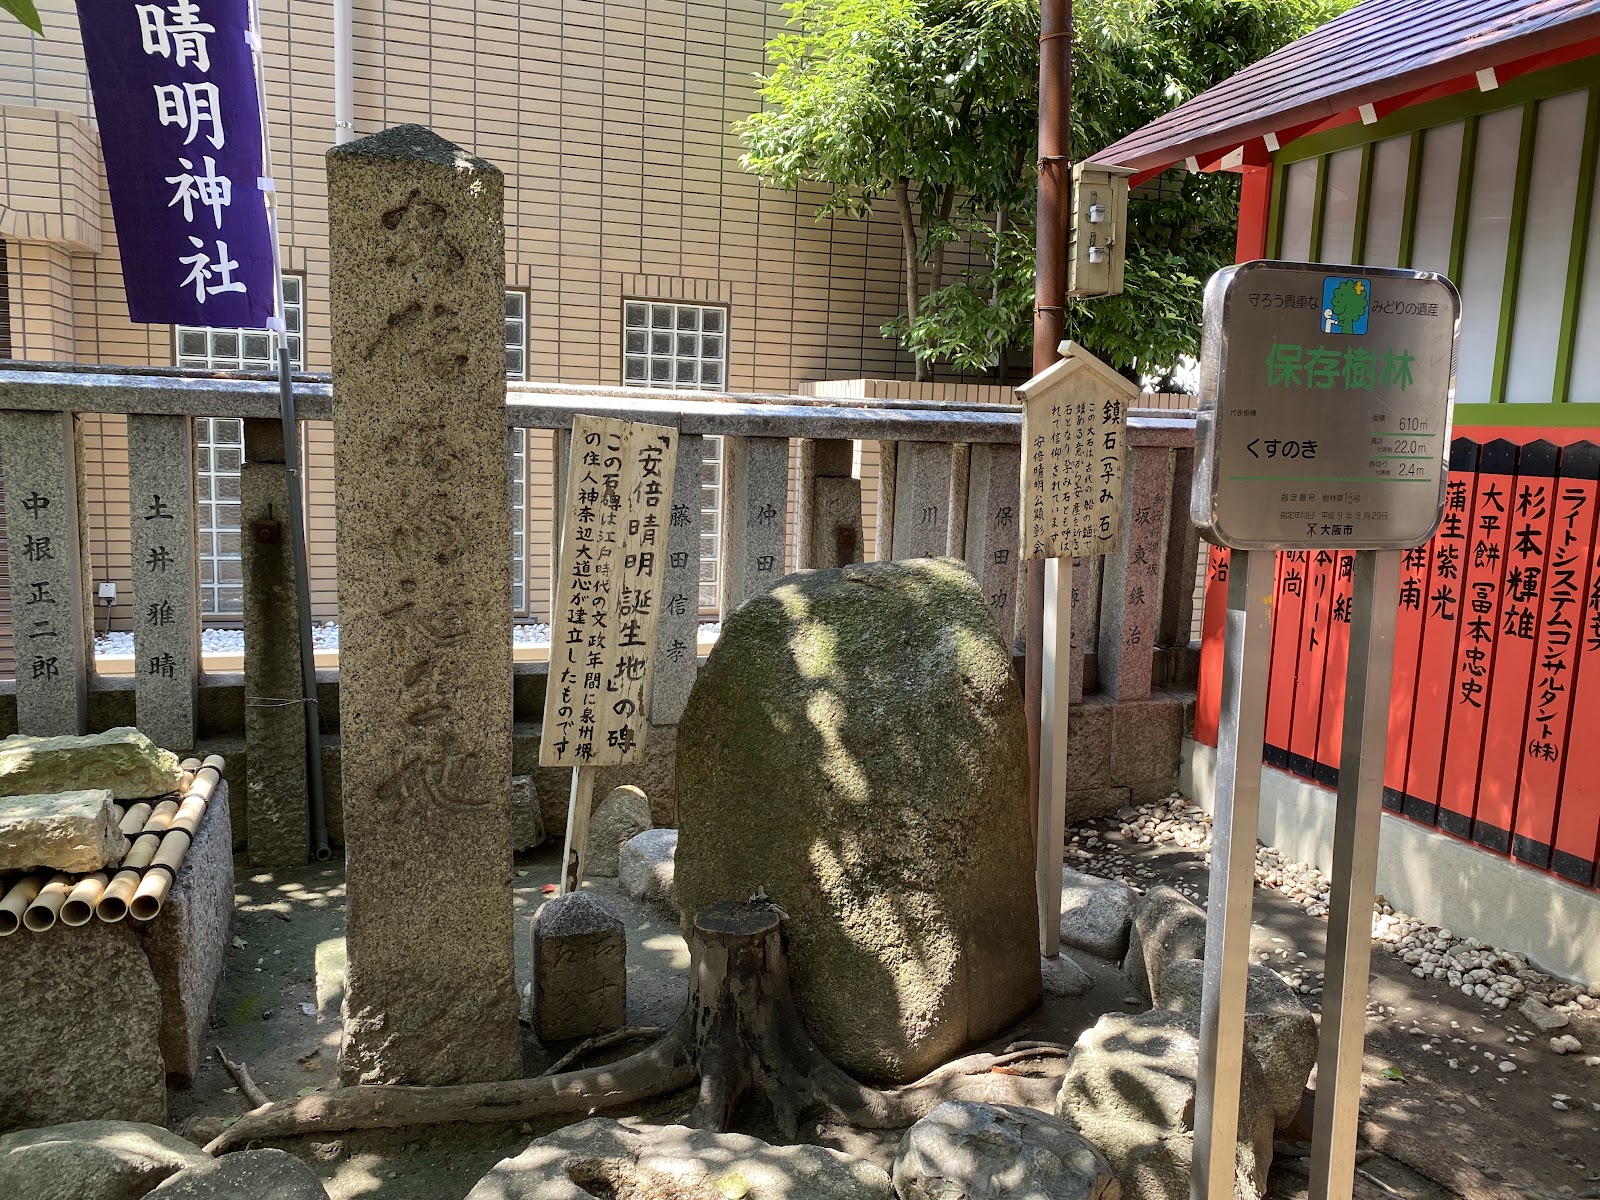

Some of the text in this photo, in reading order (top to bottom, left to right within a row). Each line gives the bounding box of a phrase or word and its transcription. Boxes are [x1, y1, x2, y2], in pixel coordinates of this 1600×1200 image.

[135, 0, 247, 304] 晴明神社
[1248, 293, 1439, 317] 守ろう貴重な みどりの遺産
[1265, 342, 1415, 392] 保存樹林
[1246, 438, 1318, 459] くすのき
[1279, 511, 1315, 520] 指定年月日
[1399, 463, 1425, 476] 2.4m
[20, 491, 60, 682] 中根正二郎
[144, 494, 176, 679] 土井雅晴
[666, 504, 692, 664] 藤田信孝
[1126, 507, 1151, 645] 坂東鉄治
[1320, 524, 1354, 536] 大阪市
[1430, 480, 1467, 621] 蒲生紫光
[1502, 485, 1546, 640] 杉本輝雄
